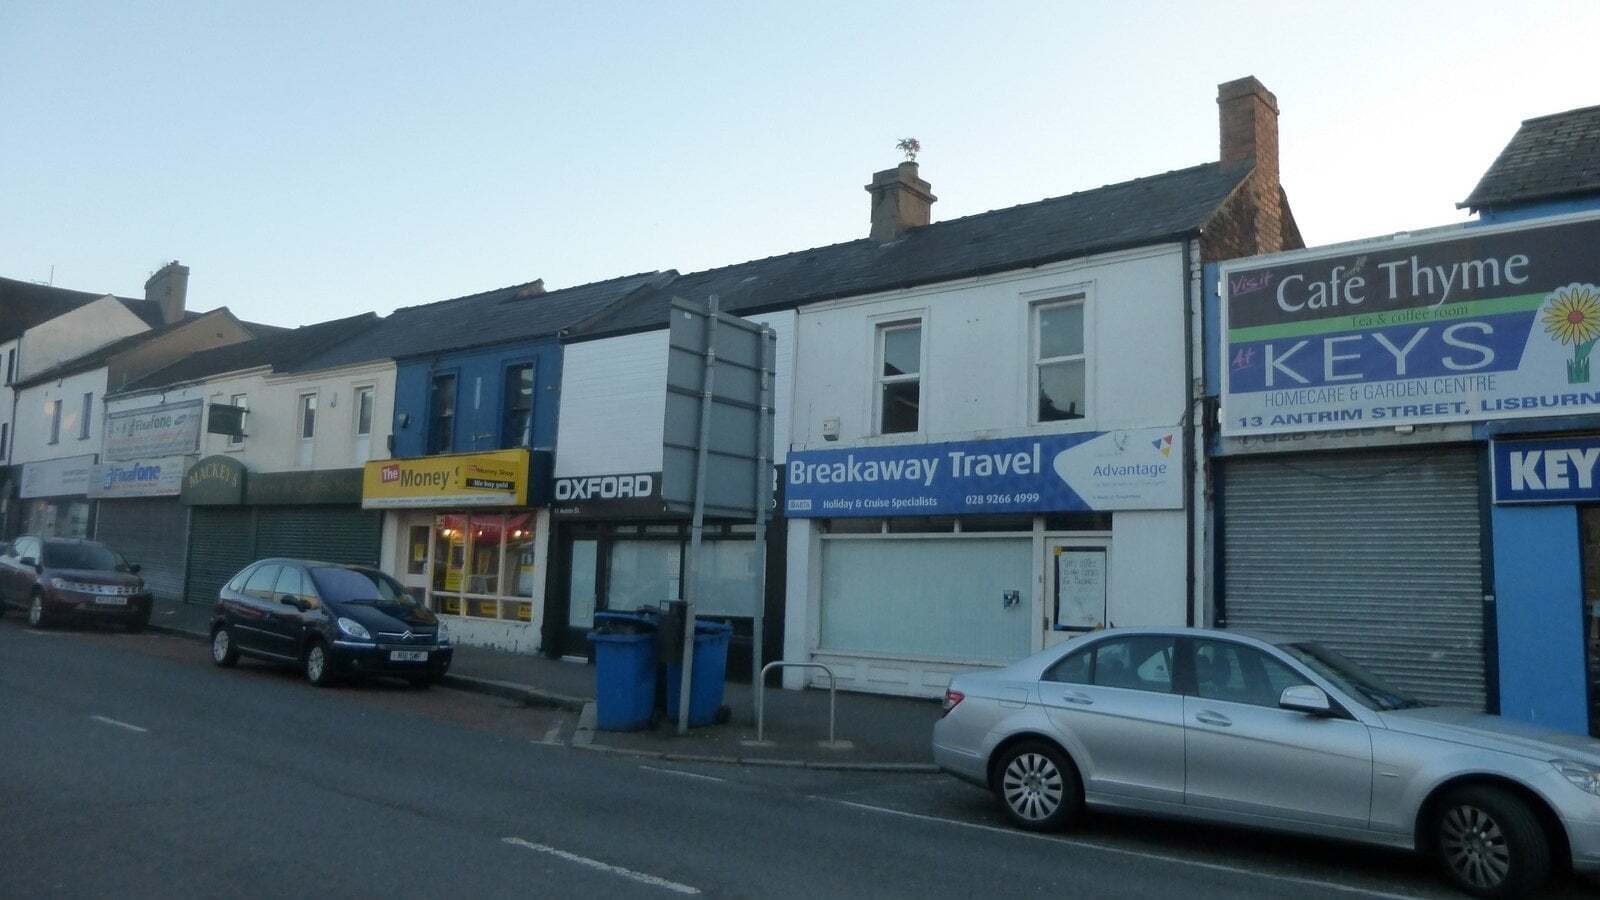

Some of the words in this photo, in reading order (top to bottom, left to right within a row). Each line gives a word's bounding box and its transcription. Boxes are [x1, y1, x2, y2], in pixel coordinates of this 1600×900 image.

[1231, 271, 1274, 294] Visit
[1378, 254, 1529, 308] Thyme
[1377, 313, 1386, 324] &
[1392, 307, 1429, 321] coffee
[1434, 304, 1468, 319] room
[1265, 322, 1495, 387] KEYS
[1265, 385, 1345, 407] HOMECARE
[1349, 387, 1358, 402] &
[1363, 379, 1428, 400] GARDEN
[1434, 374, 1497, 395] CENTRE
[1238, 416, 1263, 428] 13
[1270, 408, 1362, 426] ANTRIM
[1371, 401, 1471, 419] STREET,
[1480, 391, 1600, 412] LISBURN
[790, 455, 940, 487] Breakaway
[948, 443, 1041, 478] Travel
[1093, 463, 1168, 478] Advantage
[1510, 447, 1600, 491] KEY
[383, 466, 399, 481] The
[401, 469, 449, 490] Money
[555, 475, 652, 500] OXFORD
[823, 498, 853, 510] Holiday
[864, 497, 889, 508] Cruise
[891, 496, 938, 509] Specialists
[965, 494, 984, 505] 028
[986, 494, 1012, 504] 9266
[1013, 492, 1040, 504] 4999
